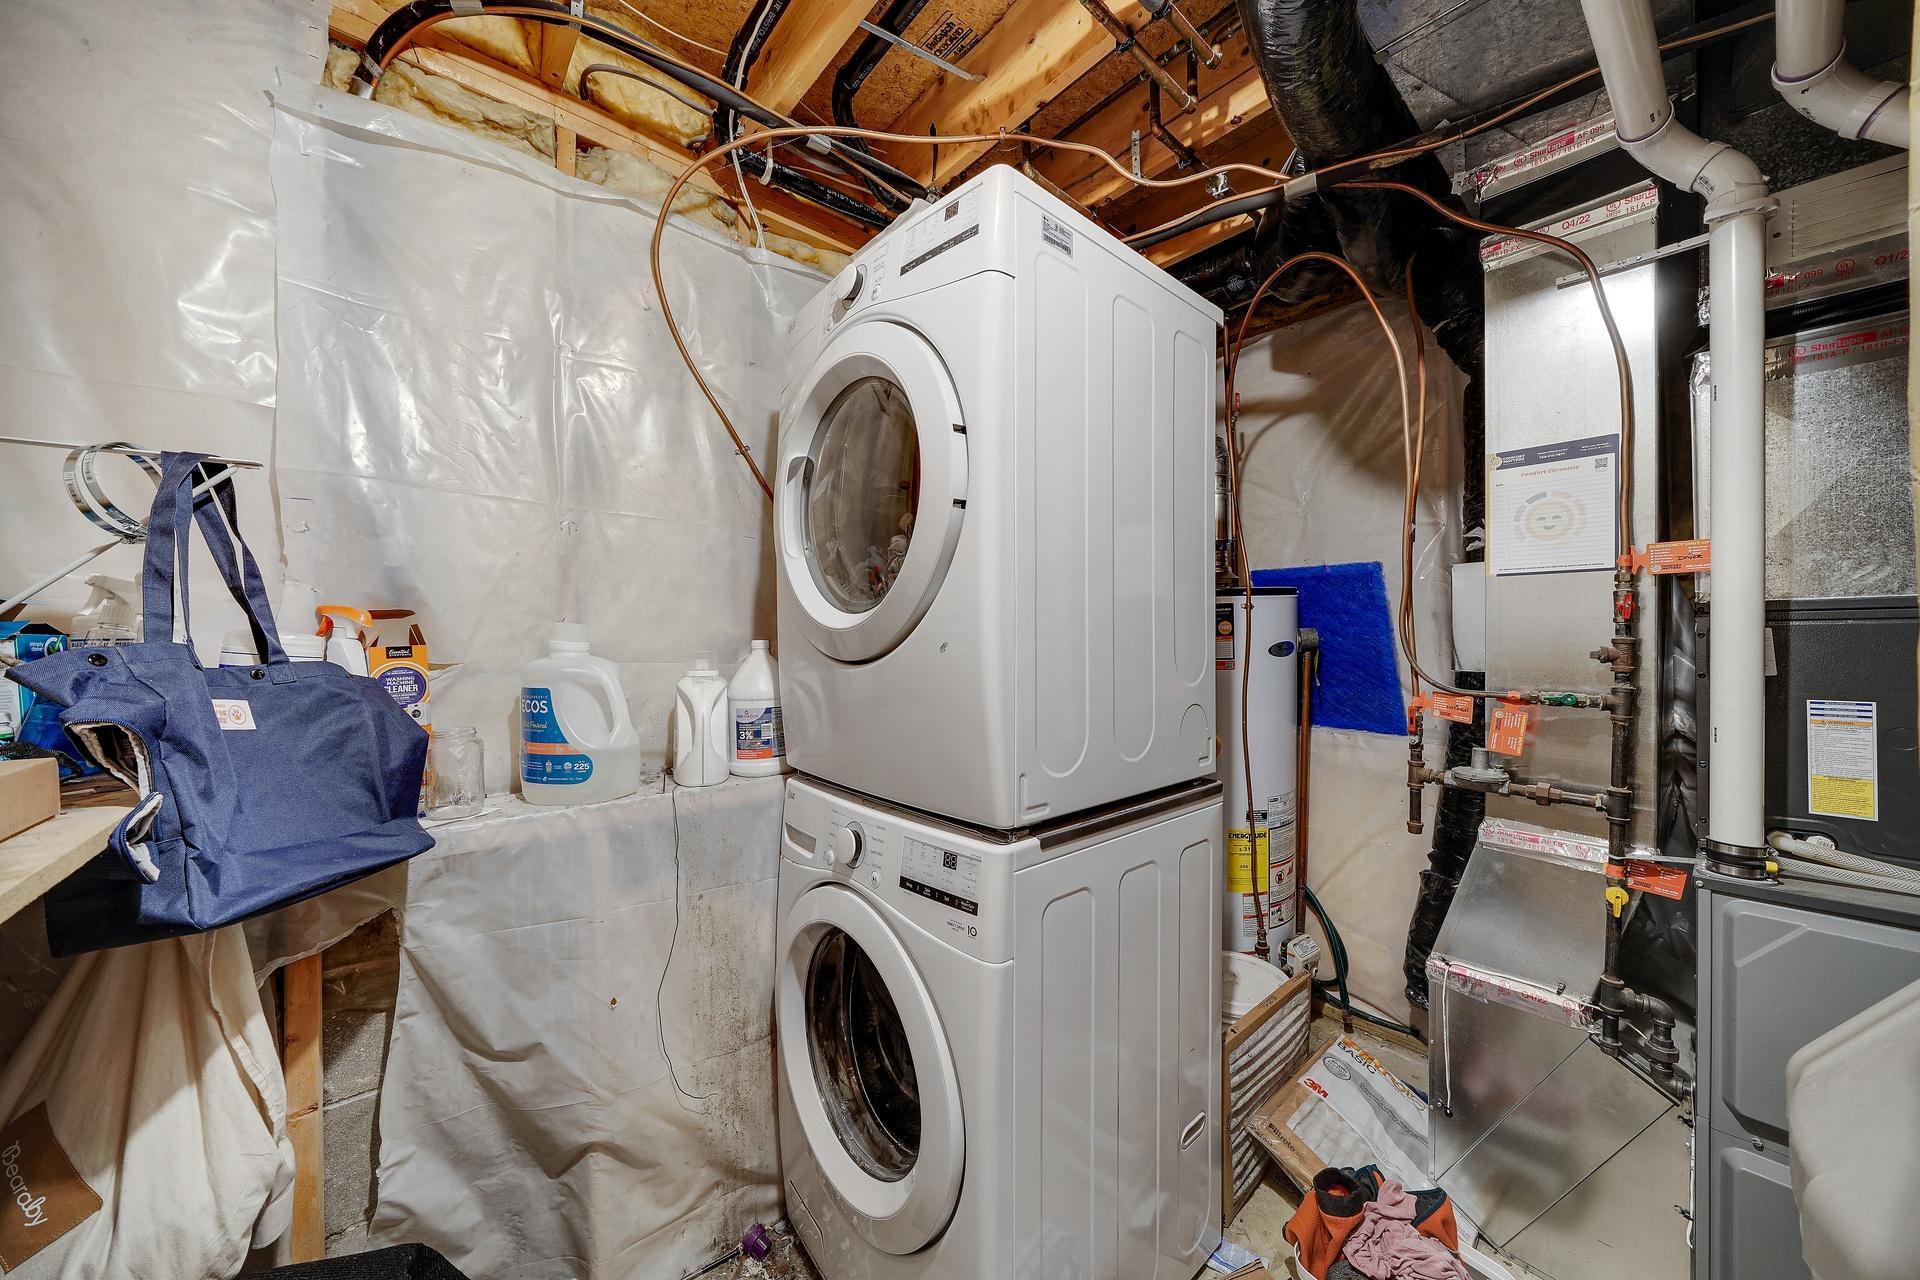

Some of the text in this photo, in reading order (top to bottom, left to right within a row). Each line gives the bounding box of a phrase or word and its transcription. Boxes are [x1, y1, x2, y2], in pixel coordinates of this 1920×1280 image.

[1529, 139, 1568, 160] Shurtape
[1576, 131, 1589, 141] AF
[1589, 124, 1605, 135] 099
[1561, 214, 1591, 231] Q4/22
[1811, 335, 1865, 353] Shurtape
[1520, 465, 1581, 478] Comfort Chronicle
[521, 699, 548, 714] ECOS
[740, 731, 753, 740] 3%
[1337, 1041, 1378, 1075] BASIC
[1303, 1077, 1329, 1099] 3M
[1, 1140, 48, 1228] Bearaby
